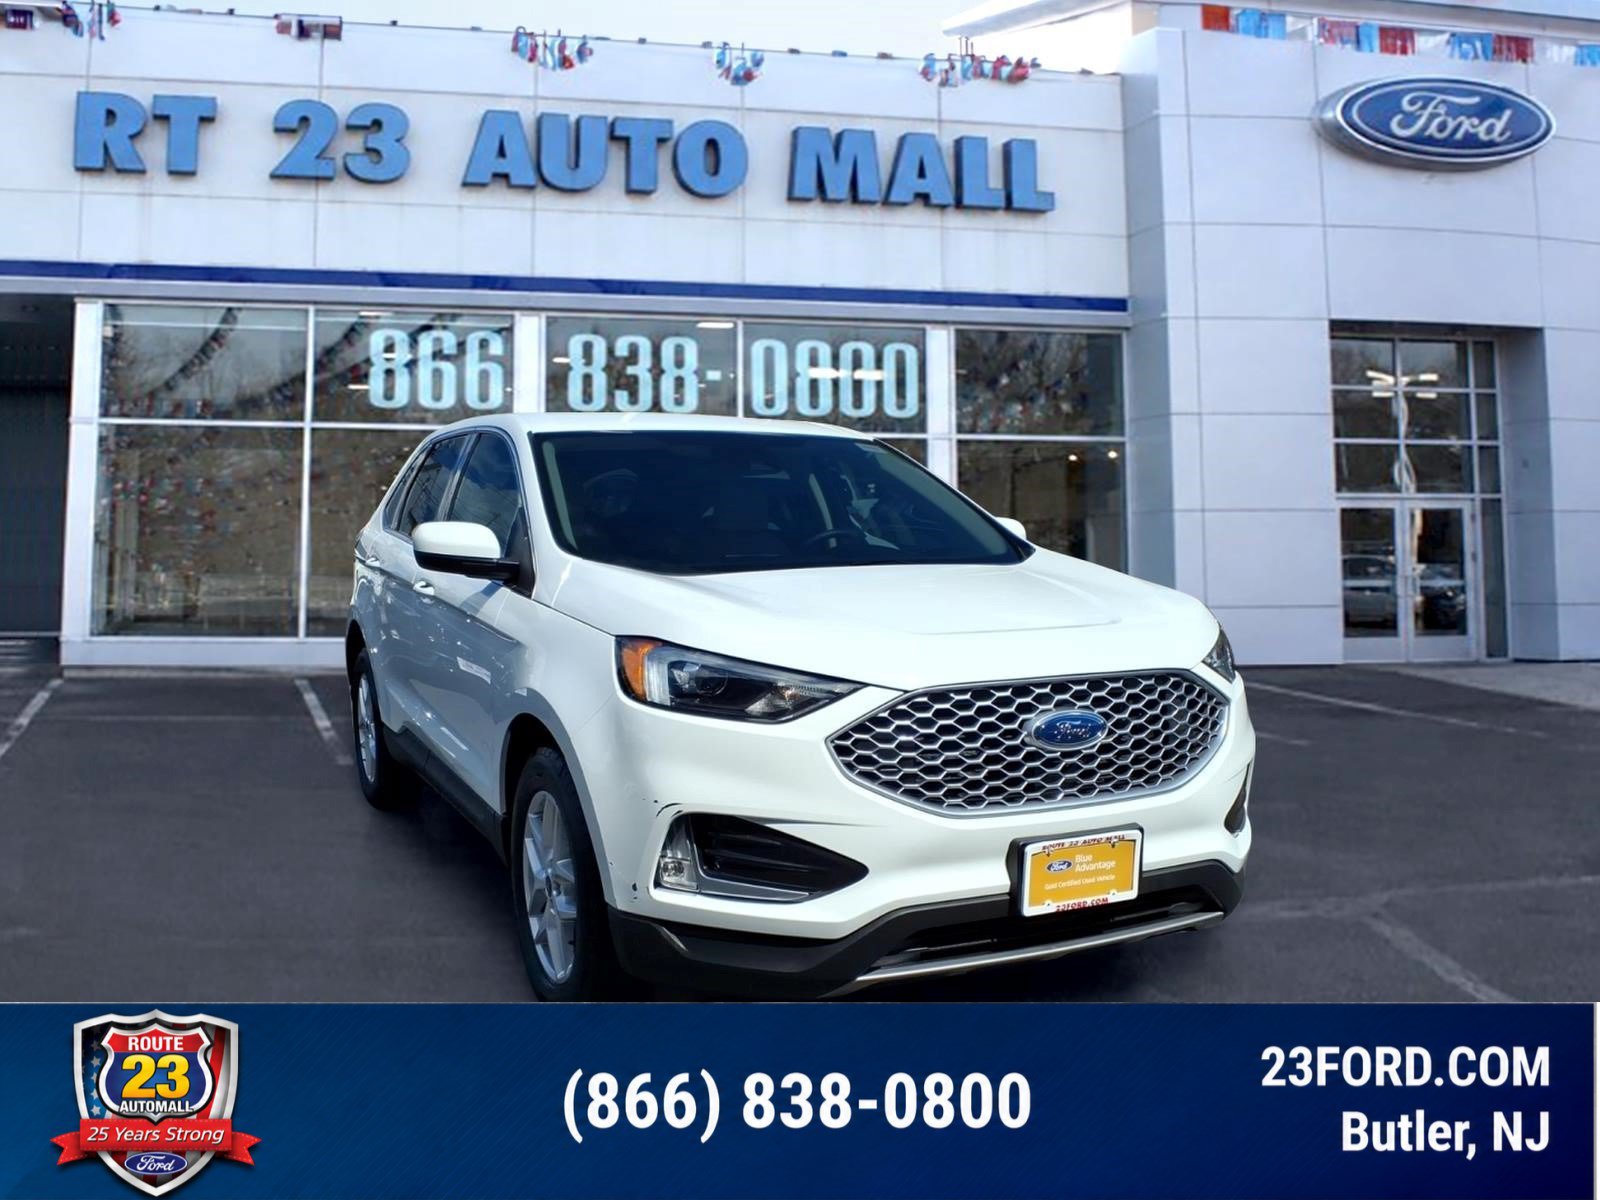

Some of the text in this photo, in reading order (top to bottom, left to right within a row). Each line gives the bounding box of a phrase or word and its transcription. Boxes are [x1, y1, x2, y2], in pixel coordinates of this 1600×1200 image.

[1389, 91, 1512, 141] Ford
[73, 91, 1055, 212] RT 23 AUTO MALL
[369, 329, 505, 410] 866
[1042, 841, 1065, 851] ROUTE
[1082, 837, 1104, 845] AUTO
[1075, 854, 1093, 862] Blue
[1075, 860, 1116, 873] Advantage
[1056, 897, 1109, 912] 23FORD.COM
